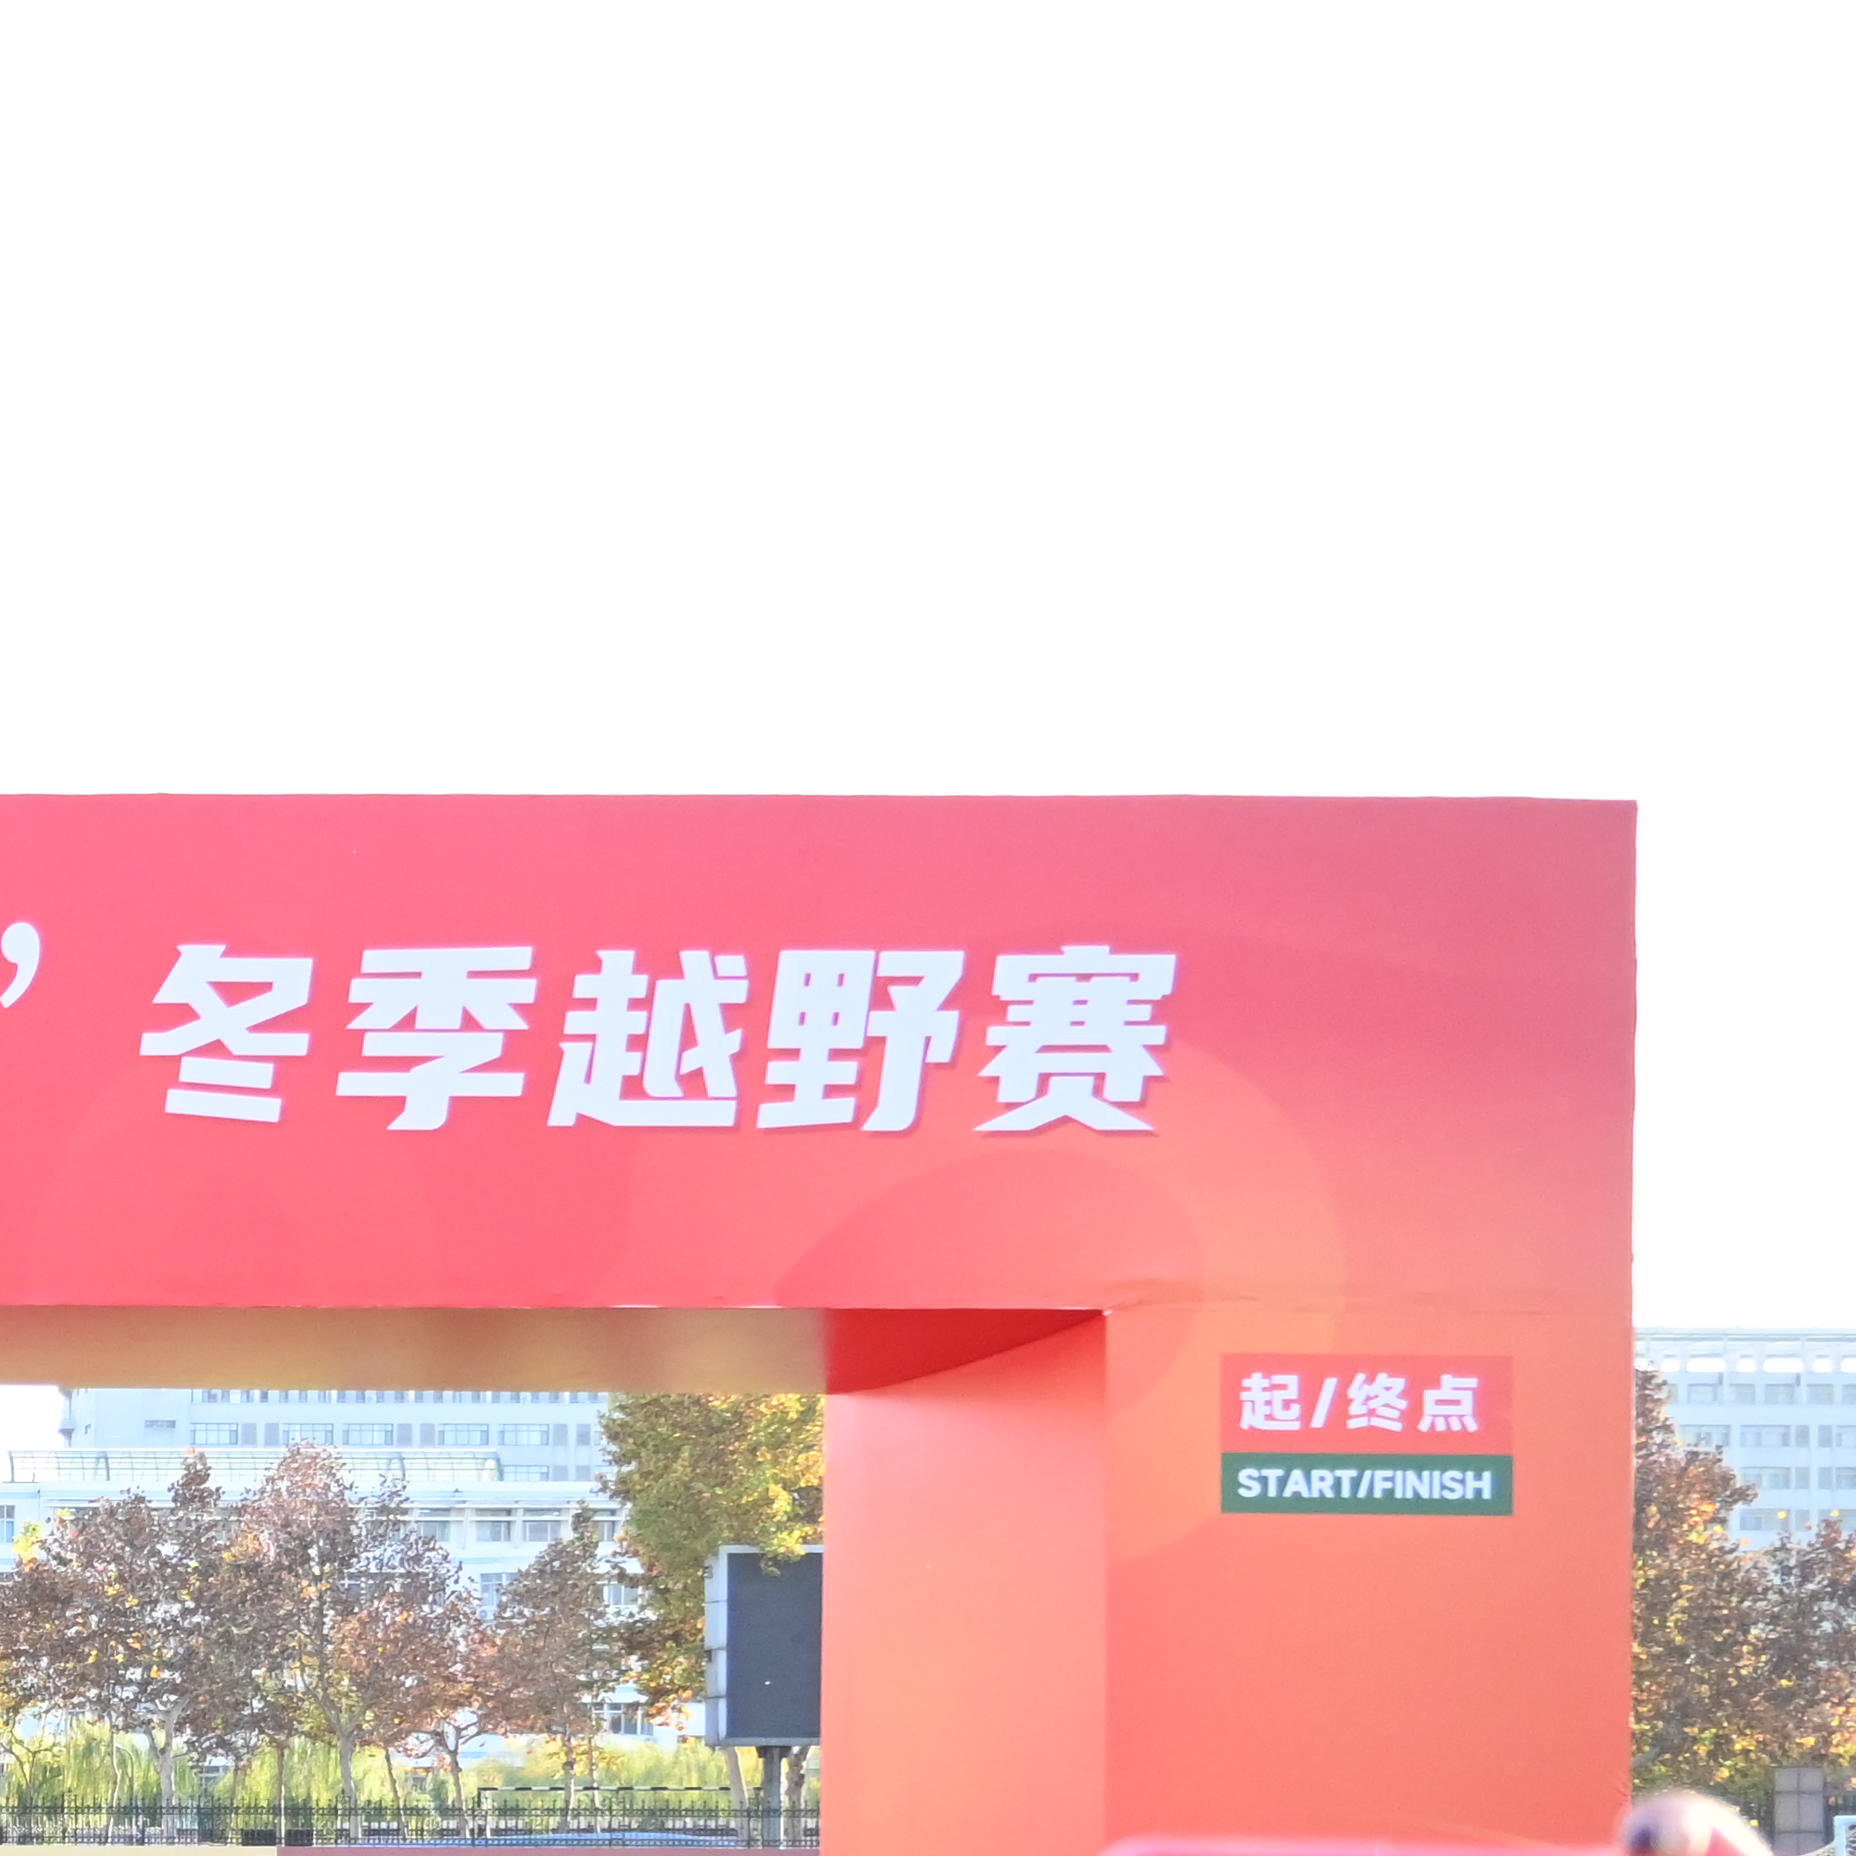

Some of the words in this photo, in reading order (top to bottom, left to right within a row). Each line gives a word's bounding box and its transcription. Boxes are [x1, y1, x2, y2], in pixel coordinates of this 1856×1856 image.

[1239, 1372, 1480, 1433] 起/终点
[1237, 1467, 1493, 1501] START/FINISH
